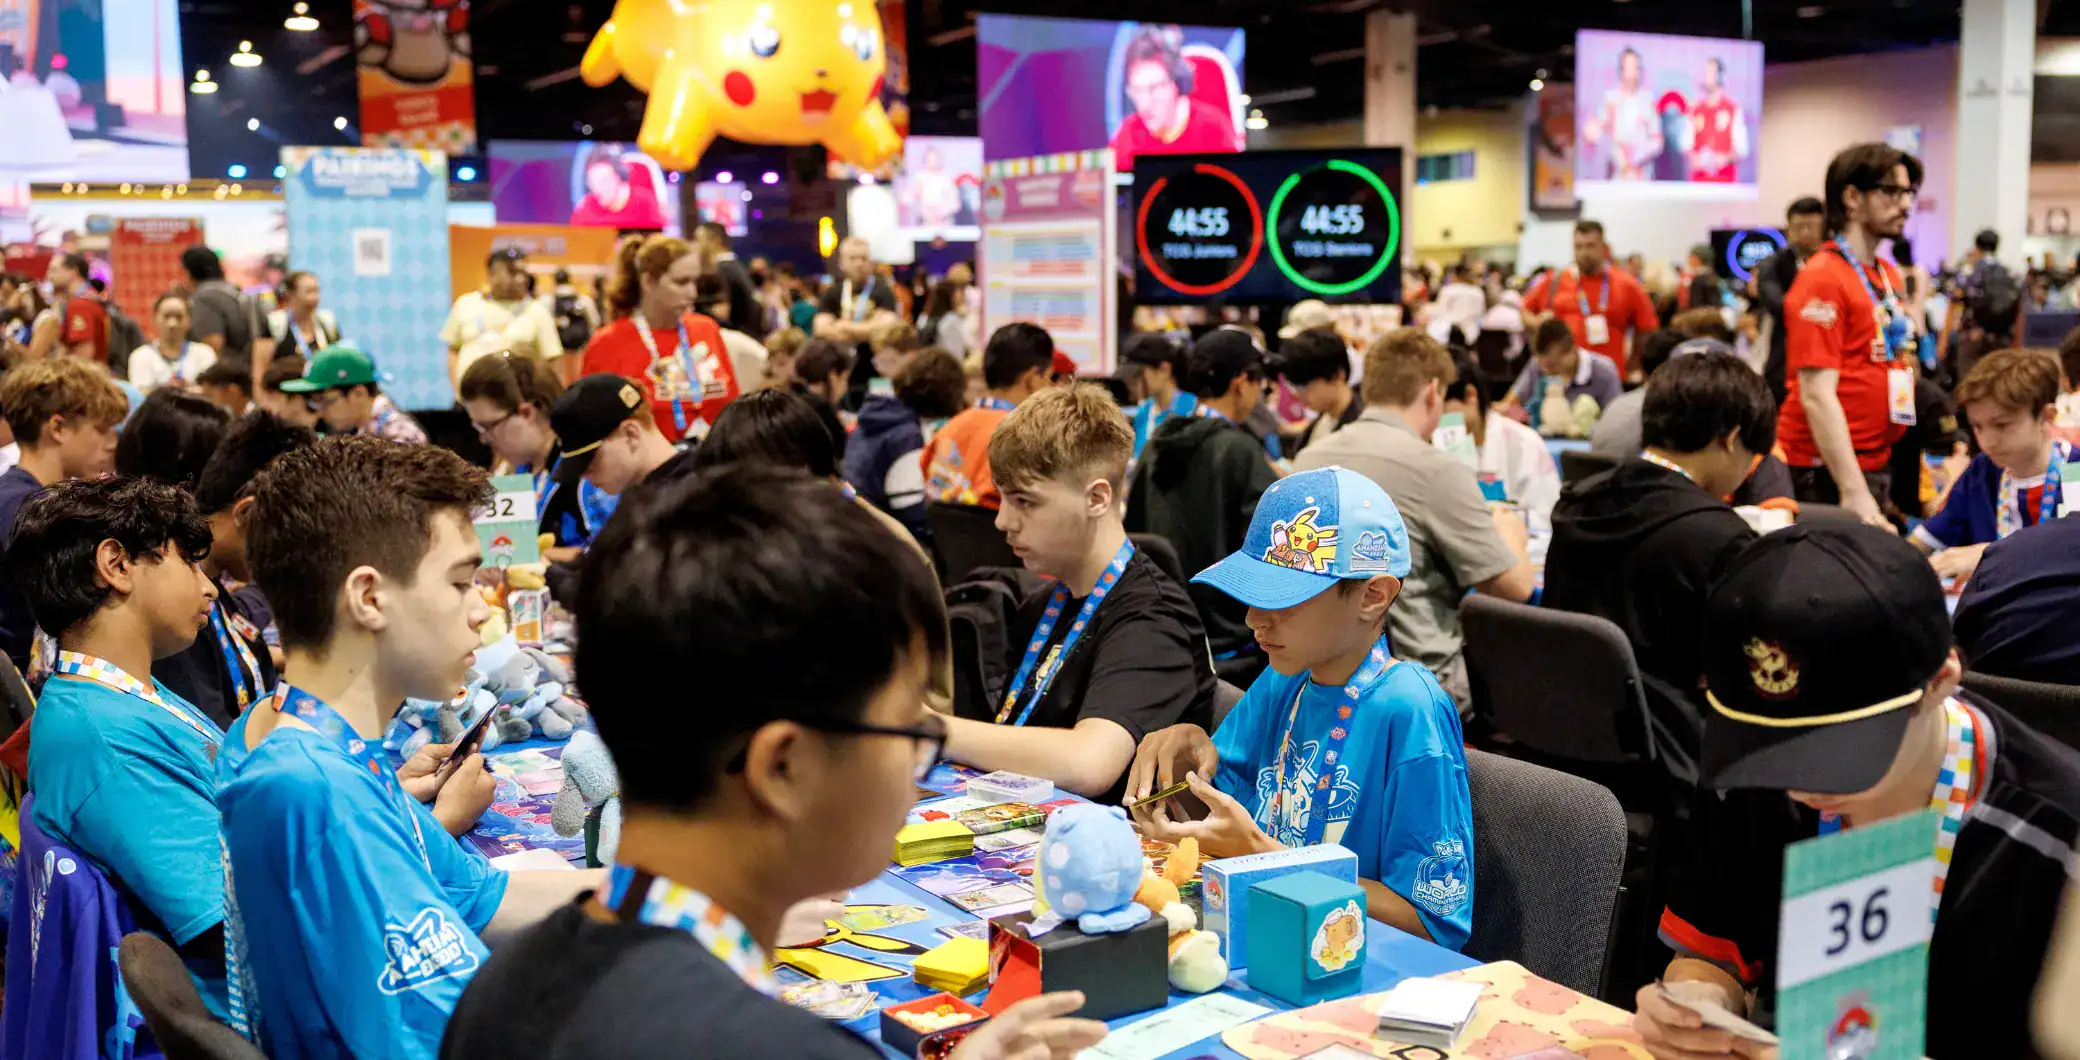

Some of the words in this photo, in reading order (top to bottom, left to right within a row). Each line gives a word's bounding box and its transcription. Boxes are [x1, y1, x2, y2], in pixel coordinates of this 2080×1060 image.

[1167, 207, 1230, 236] 44:55
[1300, 204, 1365, 234] 44:55
[486, 498, 514, 518] 32
[1416, 881, 1467, 900] WORLD
[1825, 886, 1891, 956] 36
